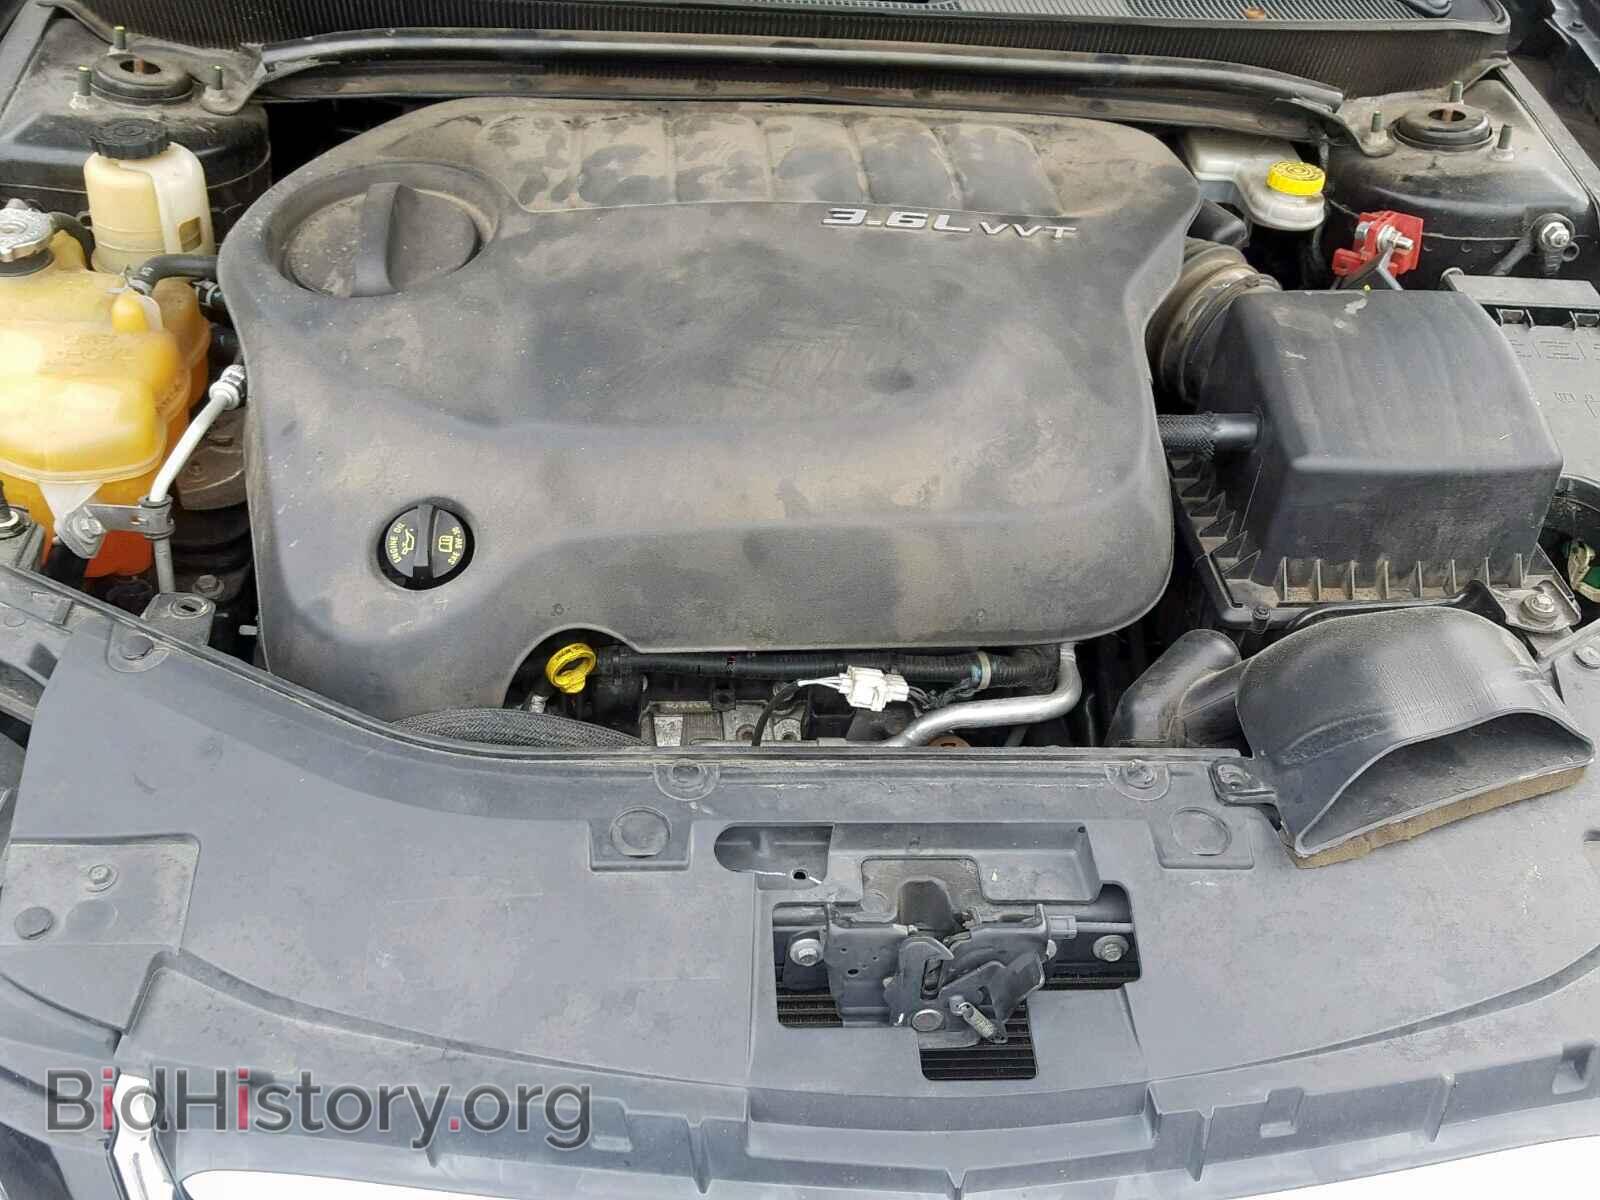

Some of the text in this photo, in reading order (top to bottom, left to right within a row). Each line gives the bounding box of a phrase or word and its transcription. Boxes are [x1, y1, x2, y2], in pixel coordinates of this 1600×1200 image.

[821, 207, 1078, 239] 3.6L VVT
[388, 522, 406, 564] ENGINE OIL
